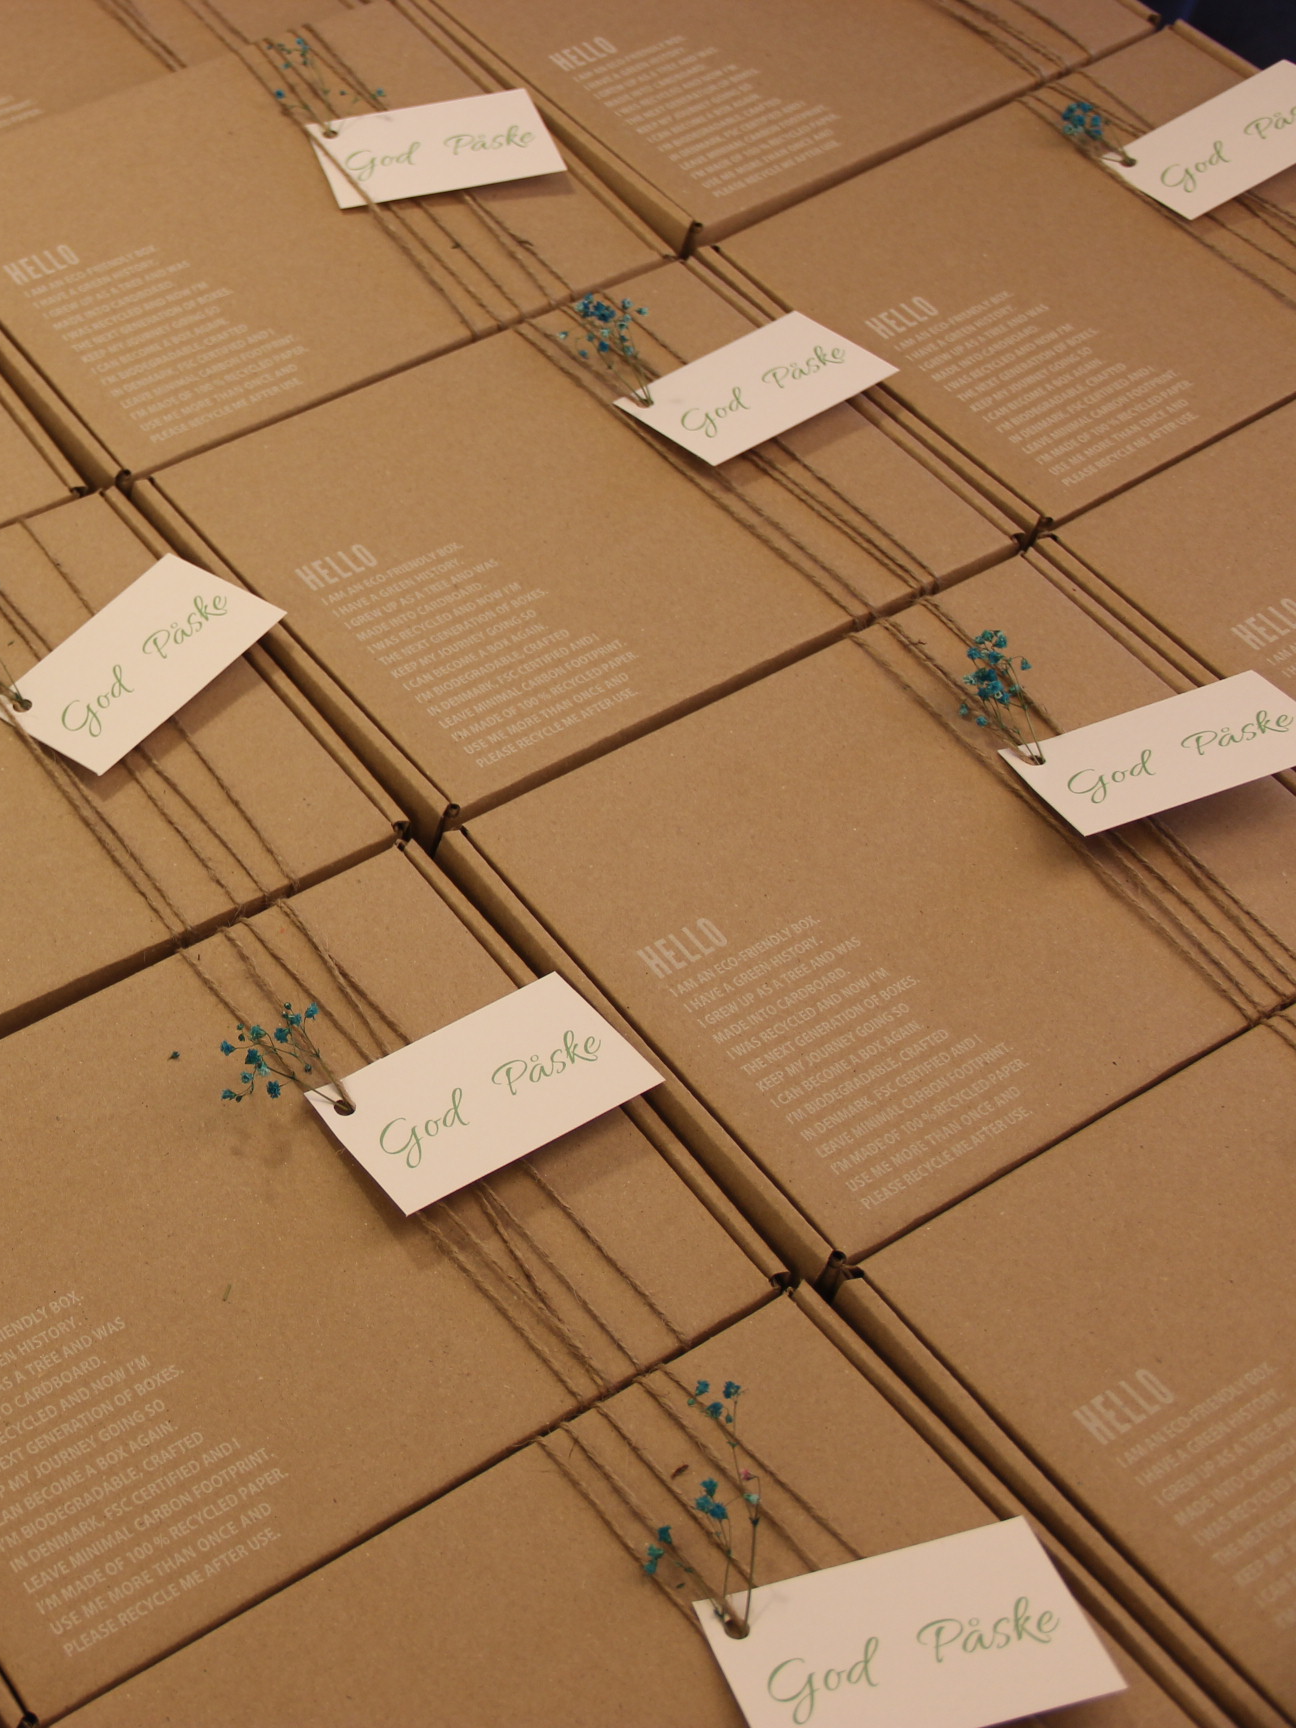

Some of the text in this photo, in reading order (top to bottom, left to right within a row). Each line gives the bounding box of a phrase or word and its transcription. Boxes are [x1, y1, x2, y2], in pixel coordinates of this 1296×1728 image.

[549, 36, 618, 72] HELLO
[344, 123, 538, 183] God Påske
[1160, 140, 1231, 193] God
[2, 244, 79, 285] HELLO
[864, 296, 938, 340] HELLO
[680, 341, 847, 440] God Påske
[294, 544, 378, 591] HELLO
[59, 590, 229, 739] God Påske
[438, 708, 475, 729] LEAVE
[472, 687, 522, 713] MINIMAL
[521, 666, 566, 690] CARBON
[1066, 709, 1295, 805] God Påske
[636, 917, 727, 979] HELLO
[755, 1002, 910, 1092] KEEP MY JOURNEY GOING SO
[379, 1029, 604, 1172] God Påske
[860, 1178, 906, 1209] PLEASE
[902, 1150, 954, 1185] RECYCLE
[950, 1140, 973, 1157] ME
[970, 1120, 1007, 1146] AFTER
[16, 1316, 82, 1355] HISTORY.
[24, 1350, 62, 1375] TREE
[62, 1335, 92, 1358] AND
[91, 1316, 125, 1340] WAS
[48, 1290, 84, 1313] BOX.
[14, 1355, 107, 1407] CARDBOARD.
[25, 1400, 114, 1454] GENERATION
[113, 1388, 132, 1406] OF
[133, 1364, 184, 1396] BOXES.
[59, 1387, 90, 1411] AND
[90, 1366, 126, 1394] NOW
[1073, 1368, 1176, 1446] HELLO
[7, 1470, 30, 1491] MY
[33, 1435, 96, 1478] JOURNEY
[97, 1410, 145, 1441] GOING
[144, 1398, 165, 1416] SO
[20, 1466, 143, 1538] BIODEGRADABLE,
[142, 1431, 203, 1471] CRAFTED
[23, 1469, 84, 1510] BECOME
[95, 1445, 128, 1470] BOX
[128, 1420, 178, 1453] AGAIN.
[9, 1555, 28, 1573] IN
[27, 1515, 105, 1562] DENMARK,
[103, 1497, 133, 1520] FSC
[131, 1460, 200, 1504] CERTIFIED
[201, 1442, 232, 1467] AND
[22, 1447, 276, 1594] LEAVE MINIMAL CARBON FOOTPRINT.
[60, 1568, 106, 1601] MADE
[104, 1556, 124, 1575] OF
[125, 1541, 153, 1563] 100
[168, 1494, 238, 1539] RECYCLED
[237, 1467, 289, 1500] PAPER.
[49, 1502, 272, 1635] USE ME MORE THAN ONCE AND
[62, 1527, 281, 1657] PLEASE RECYCLE ME AFTER USE.
[764, 1595, 1061, 1726] God Påske
